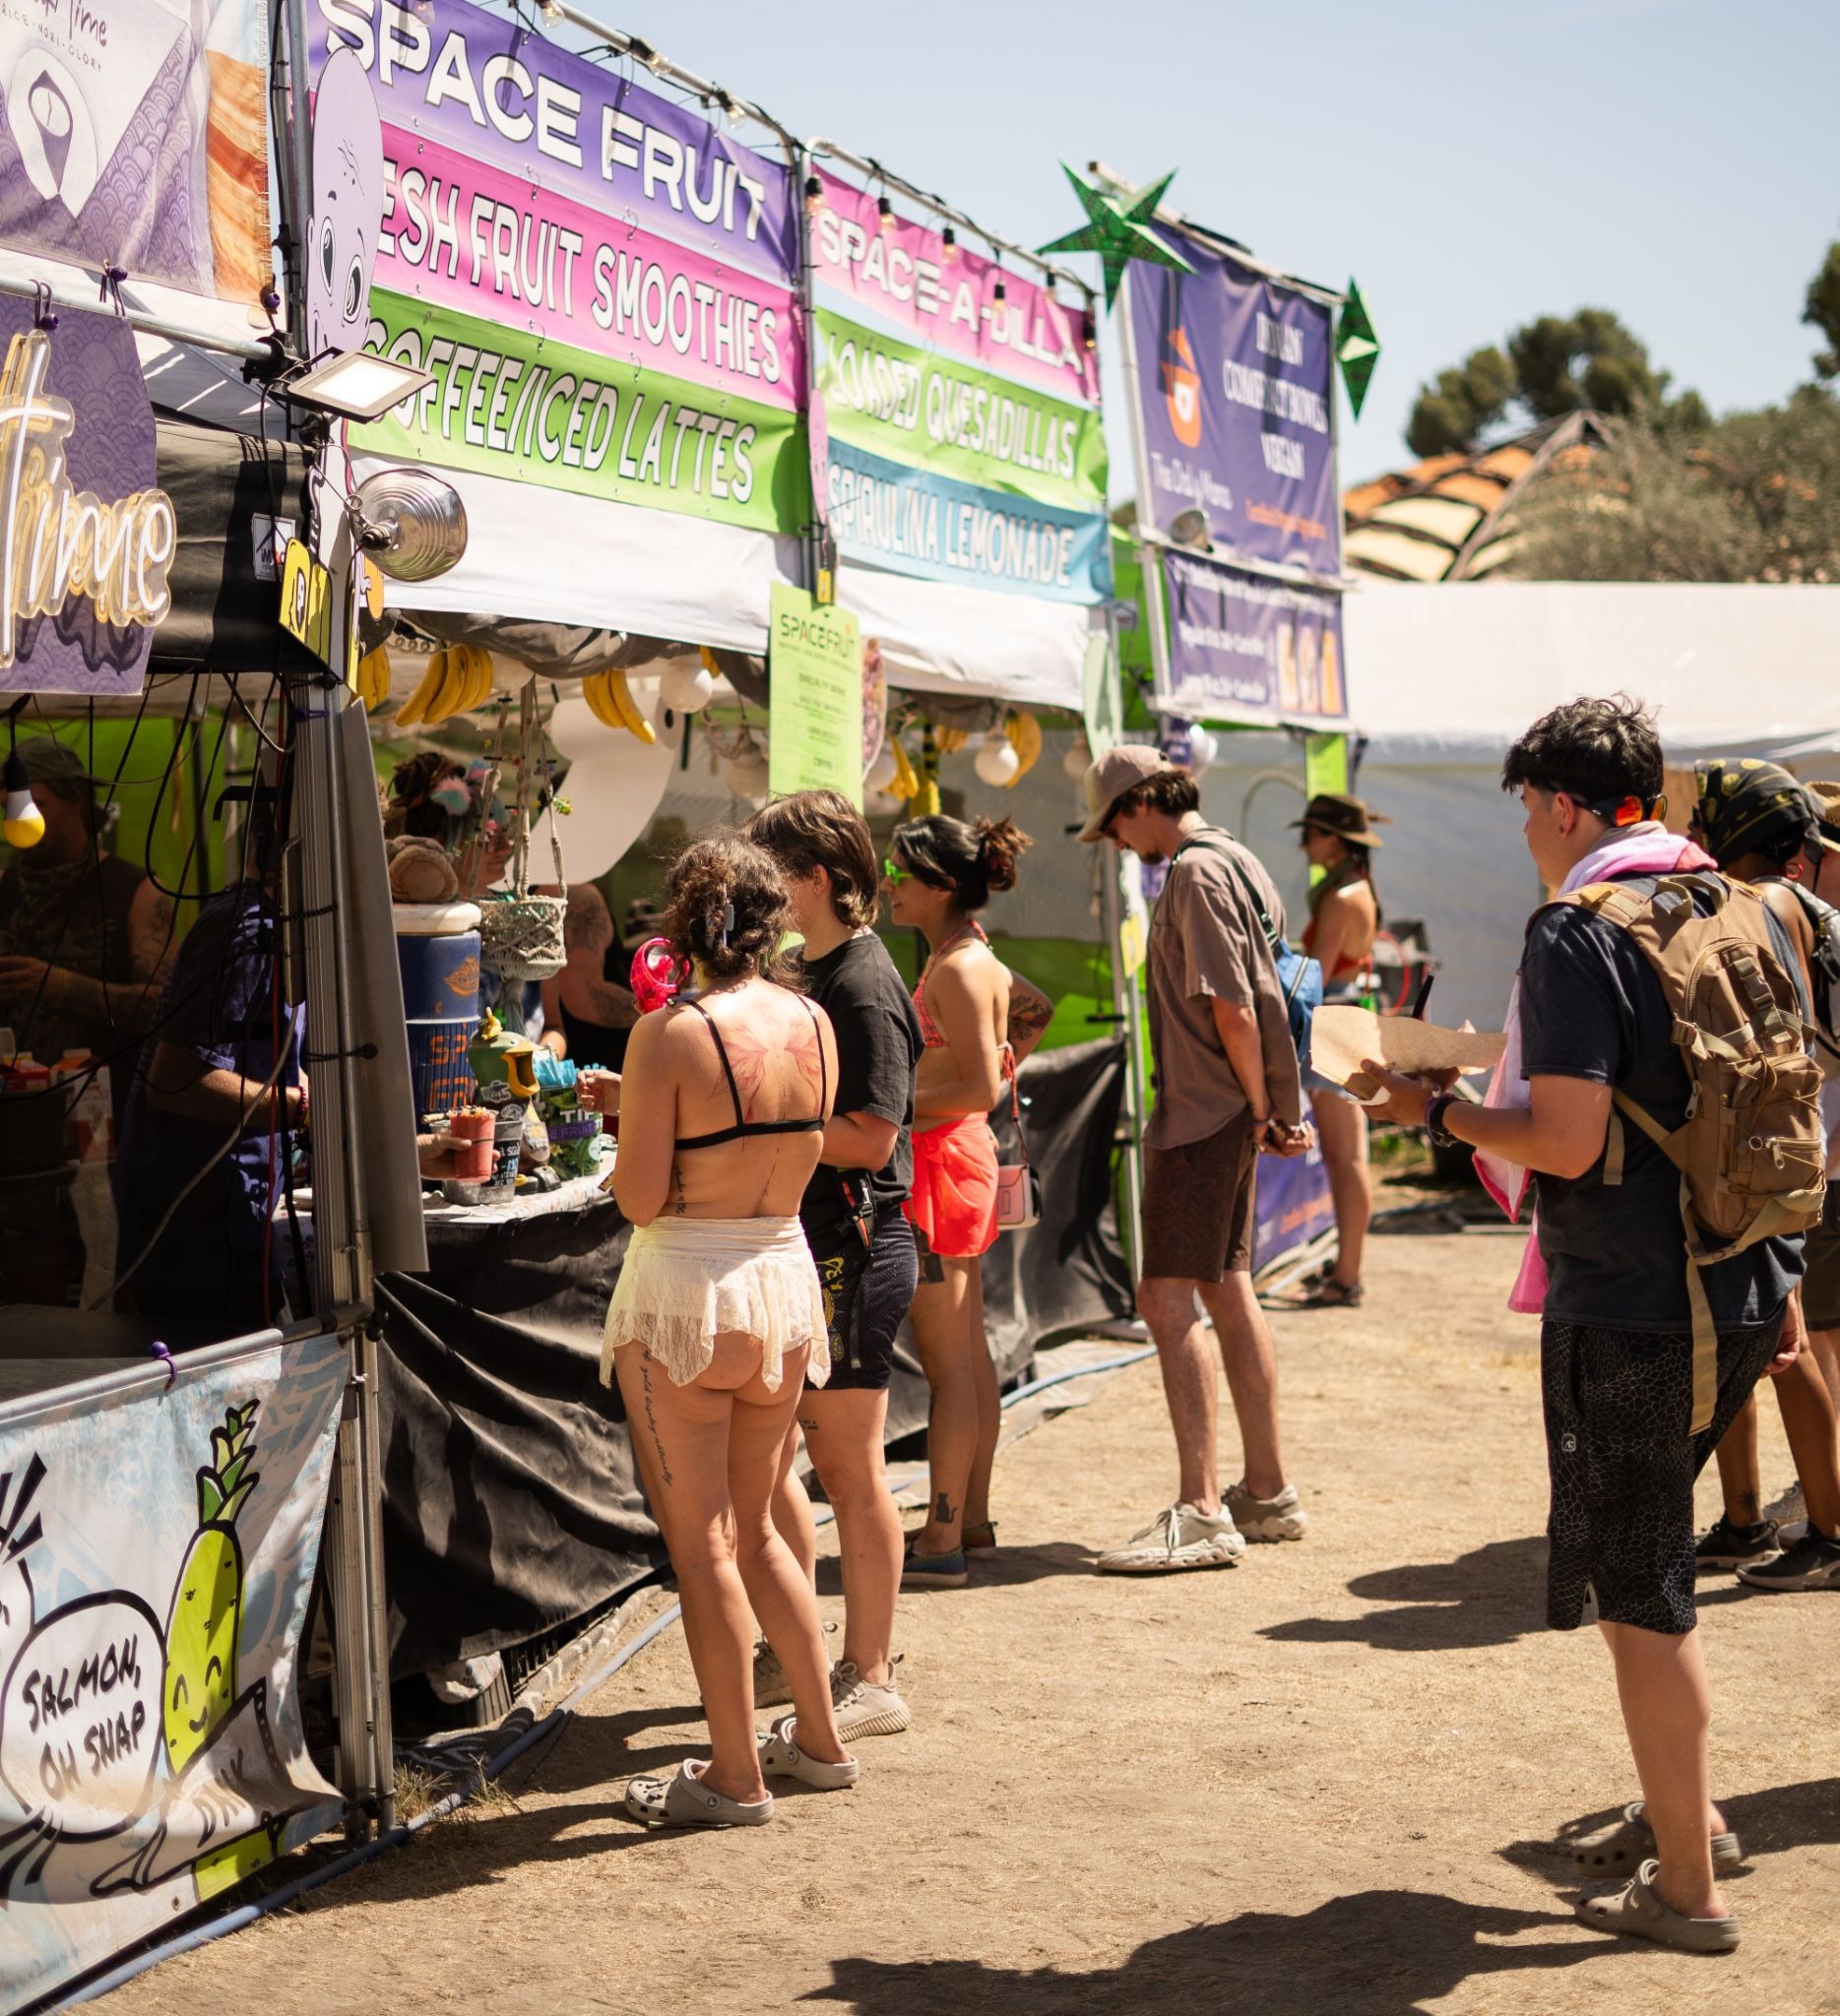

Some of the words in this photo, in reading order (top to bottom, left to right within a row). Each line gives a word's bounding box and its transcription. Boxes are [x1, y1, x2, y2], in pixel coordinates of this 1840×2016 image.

[69, 45, 101, 73] GLORY
[317, 0, 584, 170] SPACE
[601, 103, 766, 242] FRUIT
[377, 157, 461, 280] ESH
[470, 192, 583, 317] FRUIT
[591, 243, 781, 384] SMOOTHIES
[817, 207, 1084, 376] SPACE-A-DILLA
[618, 393, 756, 504] LATTES
[829, 332, 921, 431] LOADED
[925, 372, 1077, 479] QUESADILLAS
[828, 463, 939, 563] SPIRULINA
[945, 503, 1076, 588] LEMONADE
[22, 1634, 142, 1732] SALMON,
[40, 1741, 83, 1798] OH
[84, 1700, 147, 1776] SNAP
